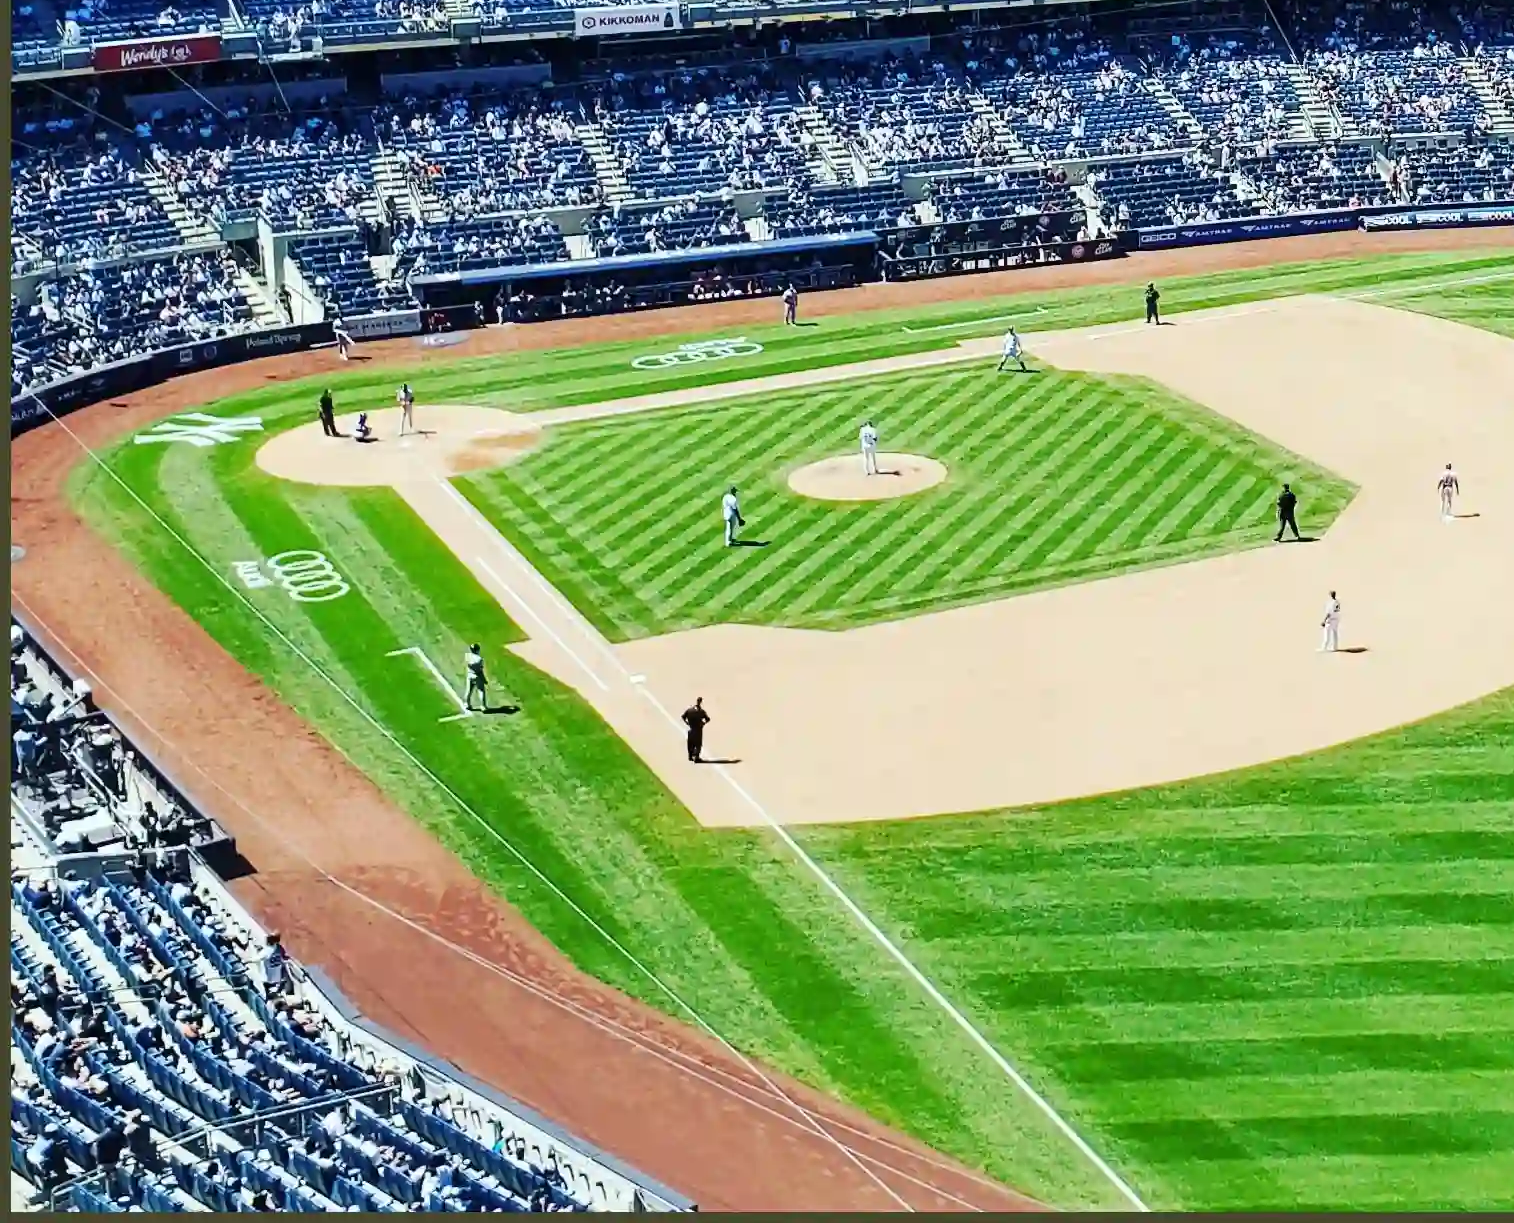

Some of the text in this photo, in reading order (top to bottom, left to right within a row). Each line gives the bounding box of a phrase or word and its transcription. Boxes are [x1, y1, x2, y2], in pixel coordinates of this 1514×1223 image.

[600, 13, 660, 26] KIKKOMAN
[121, 44, 169, 66] Wendy's
[1141, 232, 1177, 243] GEICO
